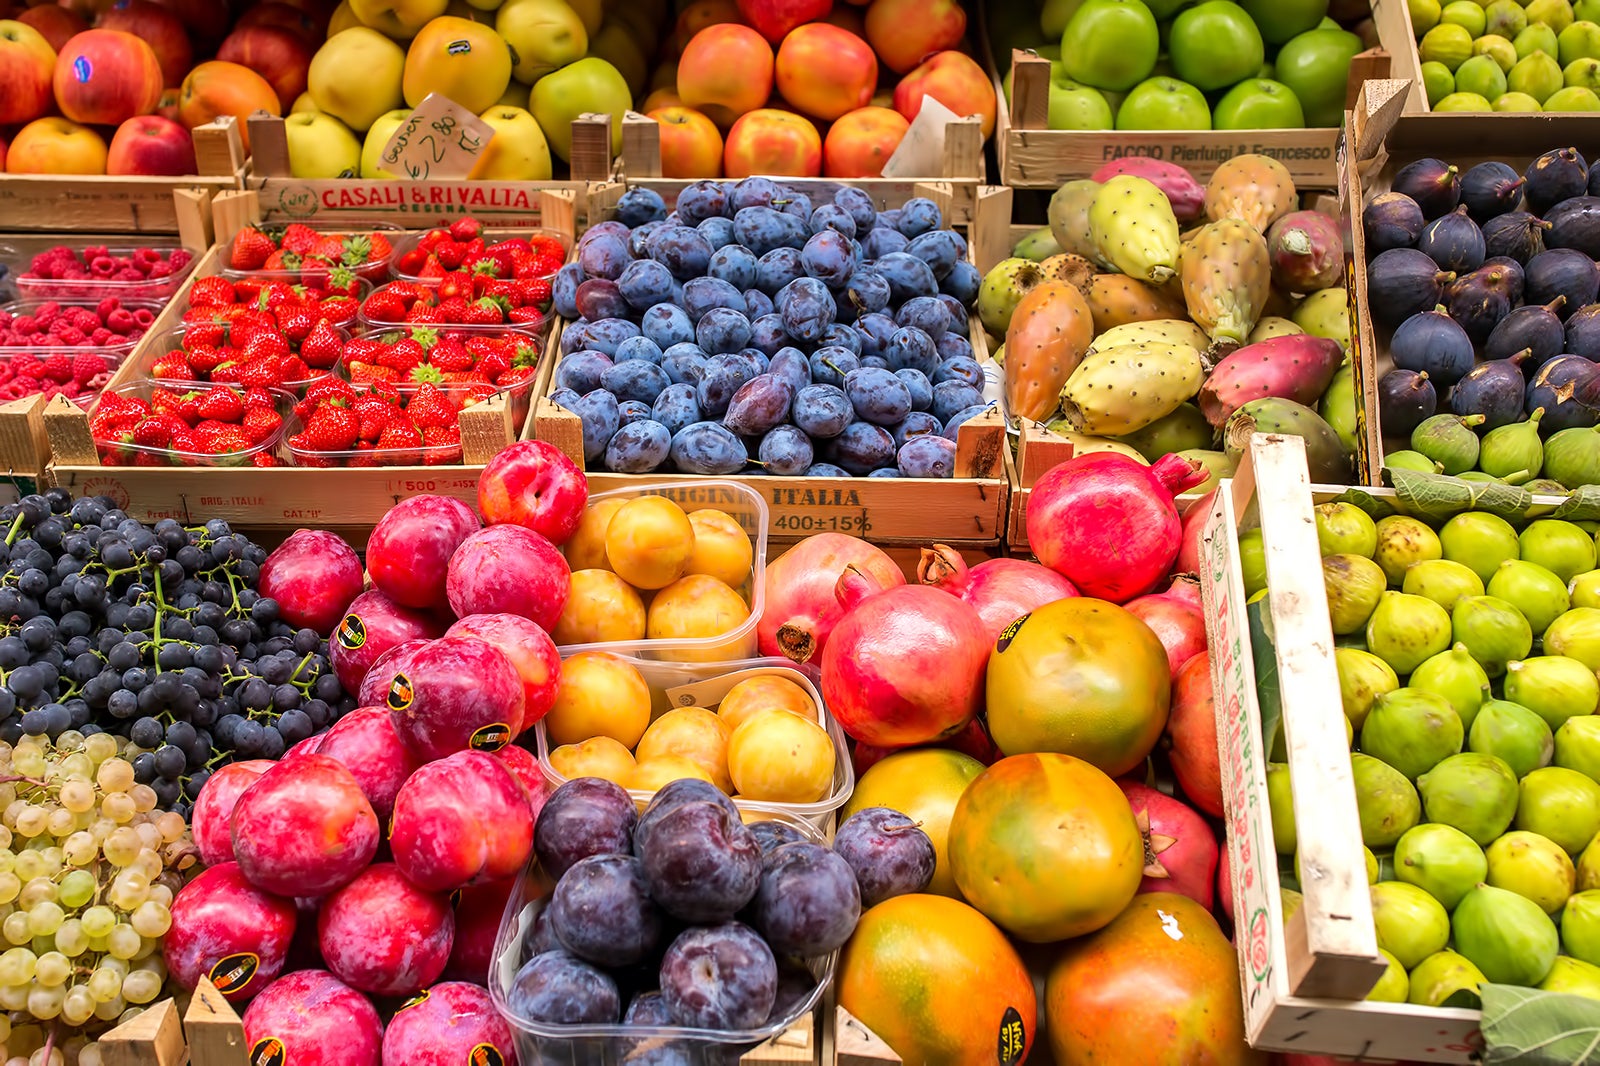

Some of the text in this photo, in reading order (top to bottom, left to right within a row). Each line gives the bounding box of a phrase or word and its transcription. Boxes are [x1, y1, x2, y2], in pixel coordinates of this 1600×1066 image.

[1103, 145, 1163, 160] FACCIO
[1171, 145, 1233, 164] Pierluigi
[1253, 144, 1330, 160] Francesco
[322, 186, 404, 208] CASALI
[411, 186, 426, 203] &
[430, 187, 530, 209] RIVALTA
[400, 204, 467, 213] CESENA
[406, 480, 436, 491] 500
[232, 497, 264, 506] ITALIA
[773, 488, 861, 506] ITALIA
